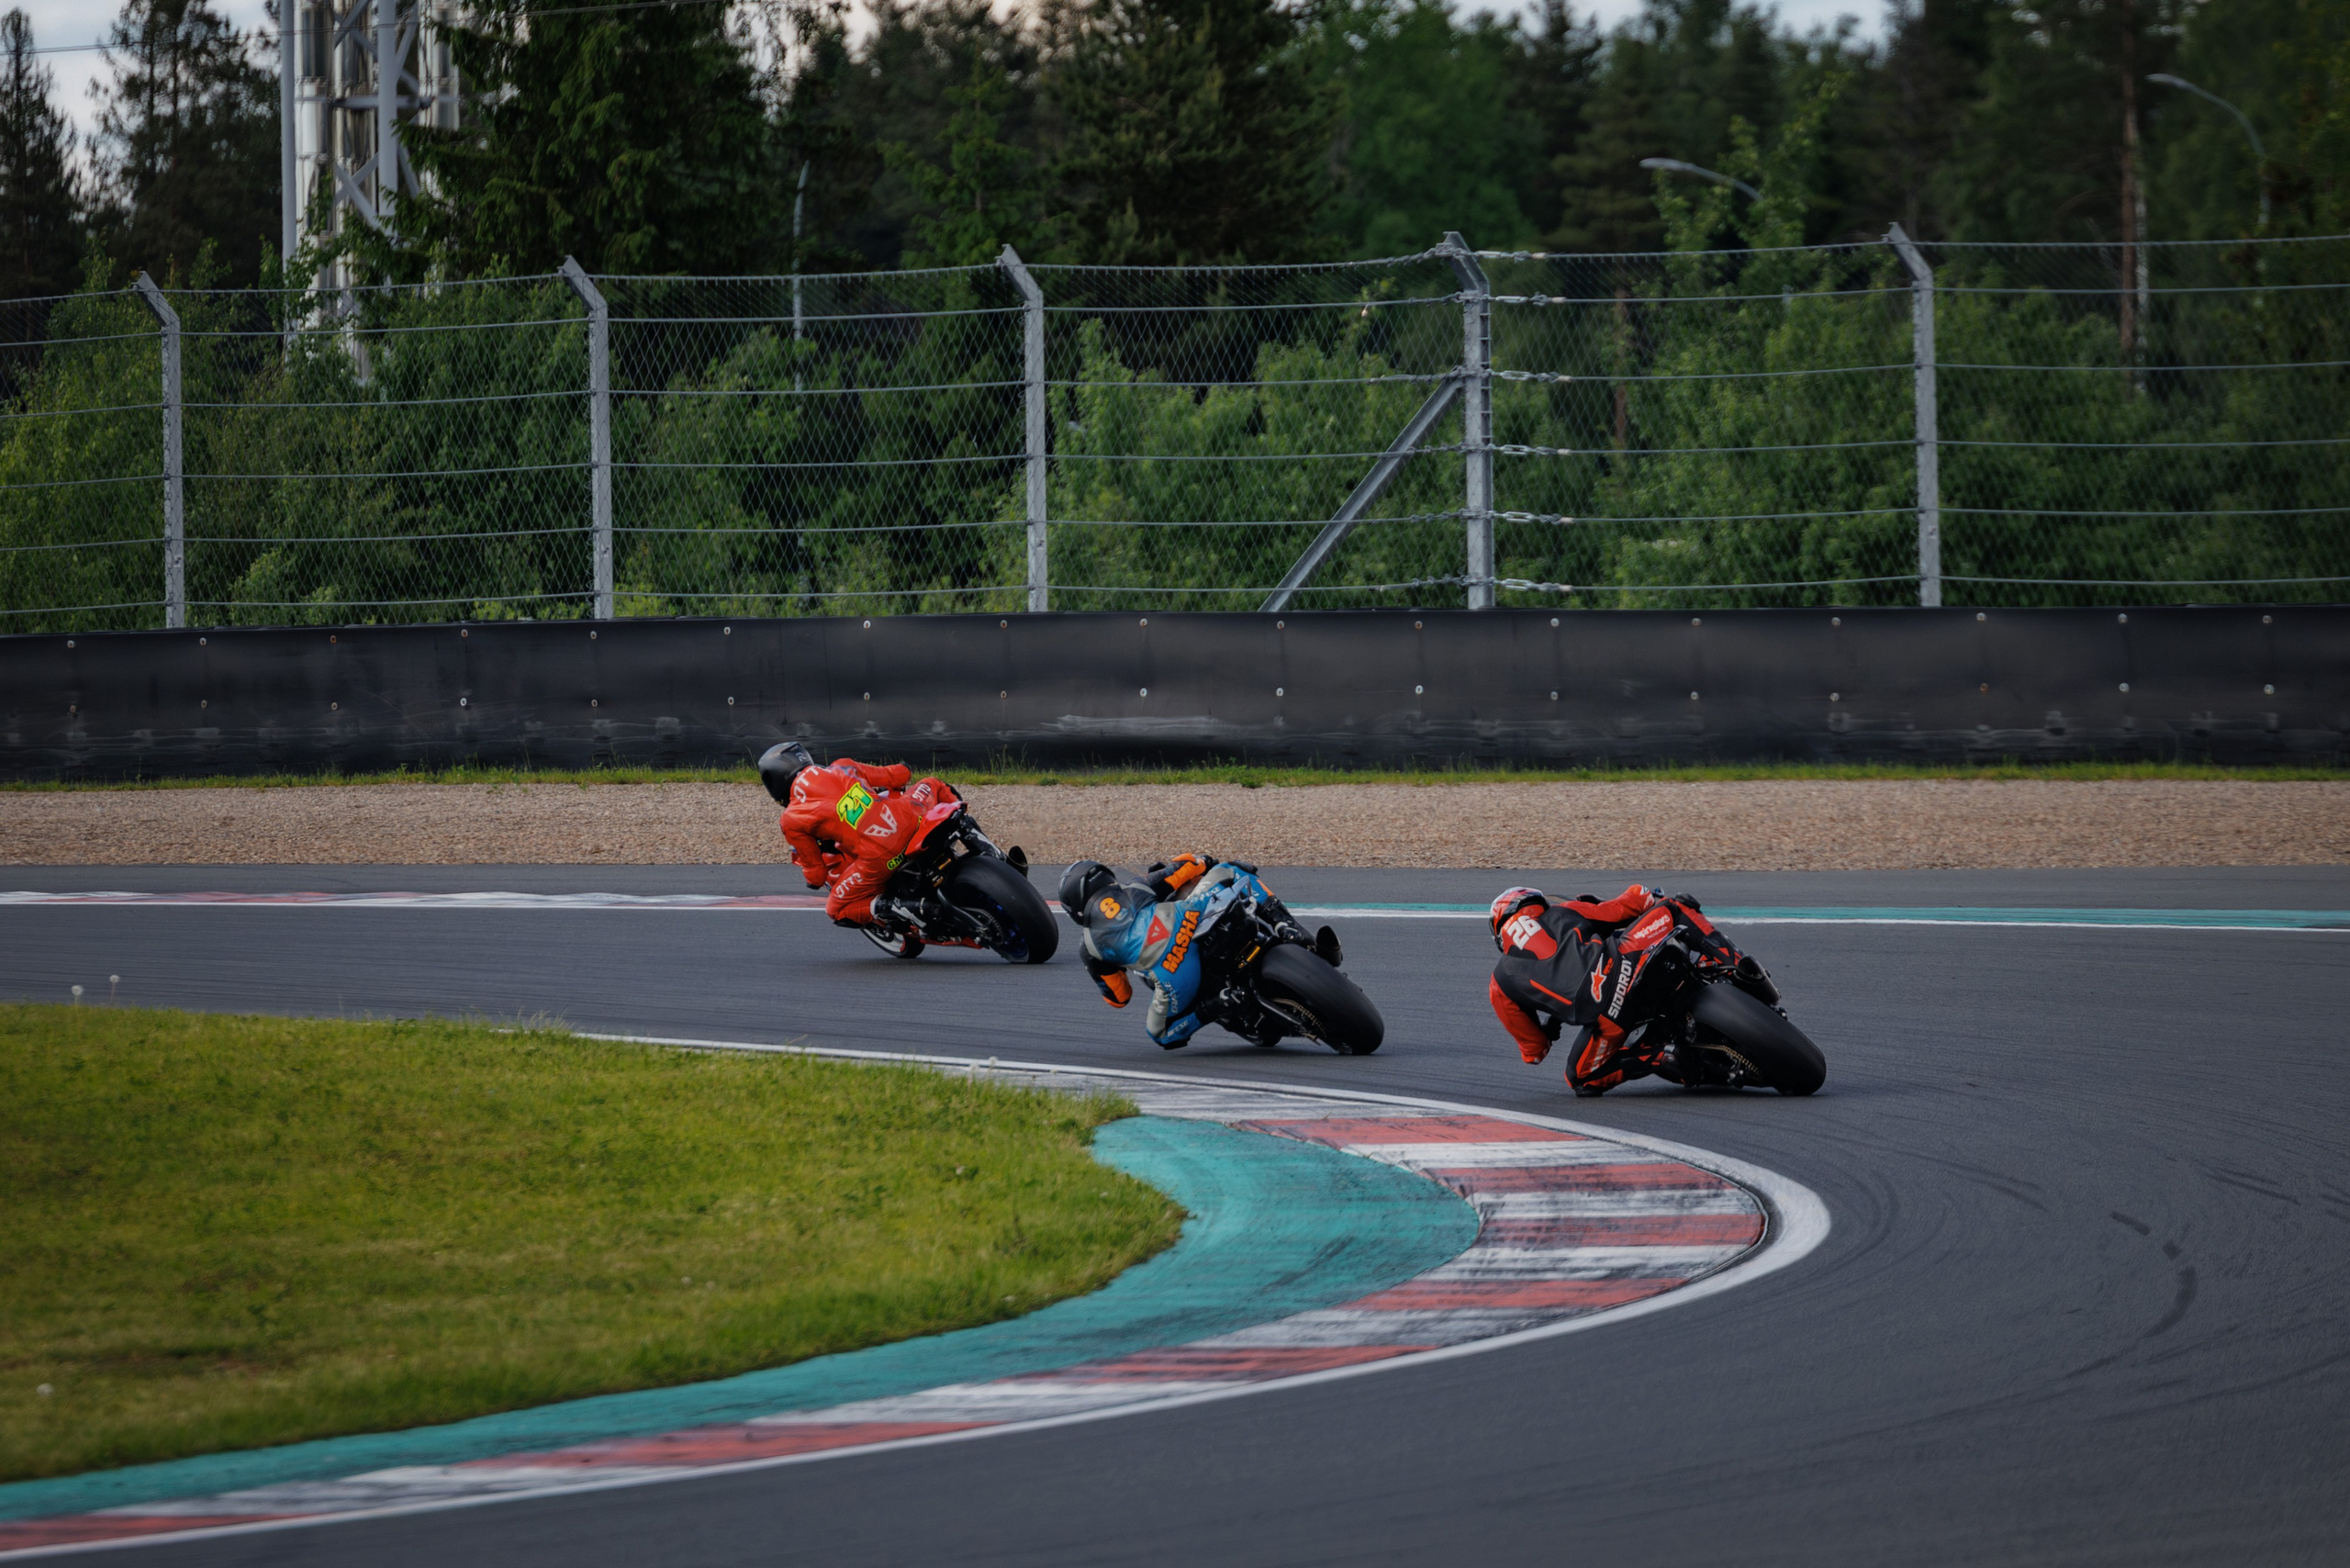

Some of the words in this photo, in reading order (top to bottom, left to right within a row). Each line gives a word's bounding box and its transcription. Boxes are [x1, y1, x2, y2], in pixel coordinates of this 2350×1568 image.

[793, 765, 833, 803] OTT
[836, 782, 874, 830] 21
[1100, 897, 1121, 920] 8
[1161, 910, 1201, 974] MASHA
[1506, 915, 1542, 950] 26
